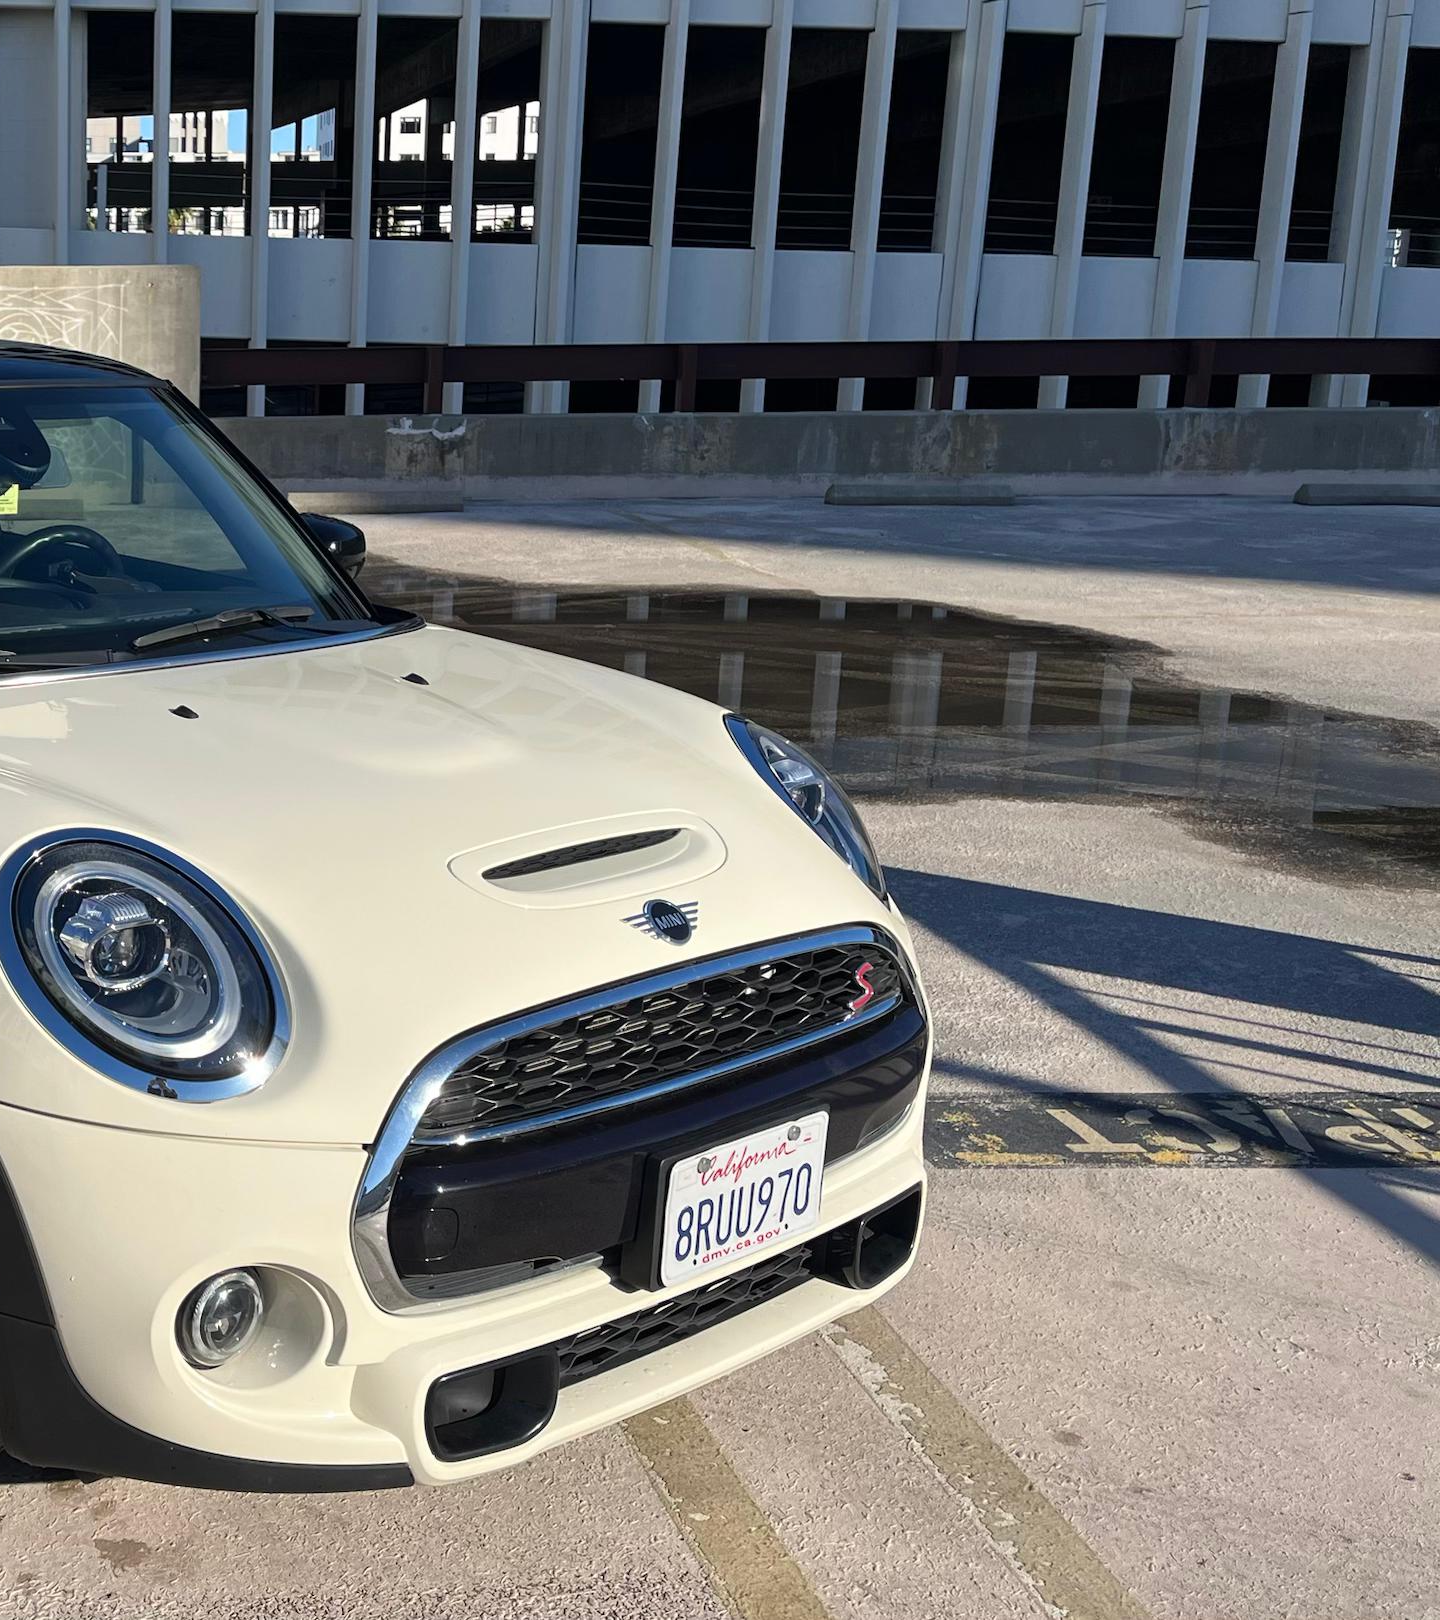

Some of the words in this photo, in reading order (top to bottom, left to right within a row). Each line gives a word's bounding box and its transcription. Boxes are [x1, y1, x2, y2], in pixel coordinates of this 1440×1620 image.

[654, 912, 686, 931] MINI
[699, 1142, 797, 1186] California
[675, 1162, 812, 1262] 8RUU970
[702, 1227, 782, 1265] dmv.ca.gov
